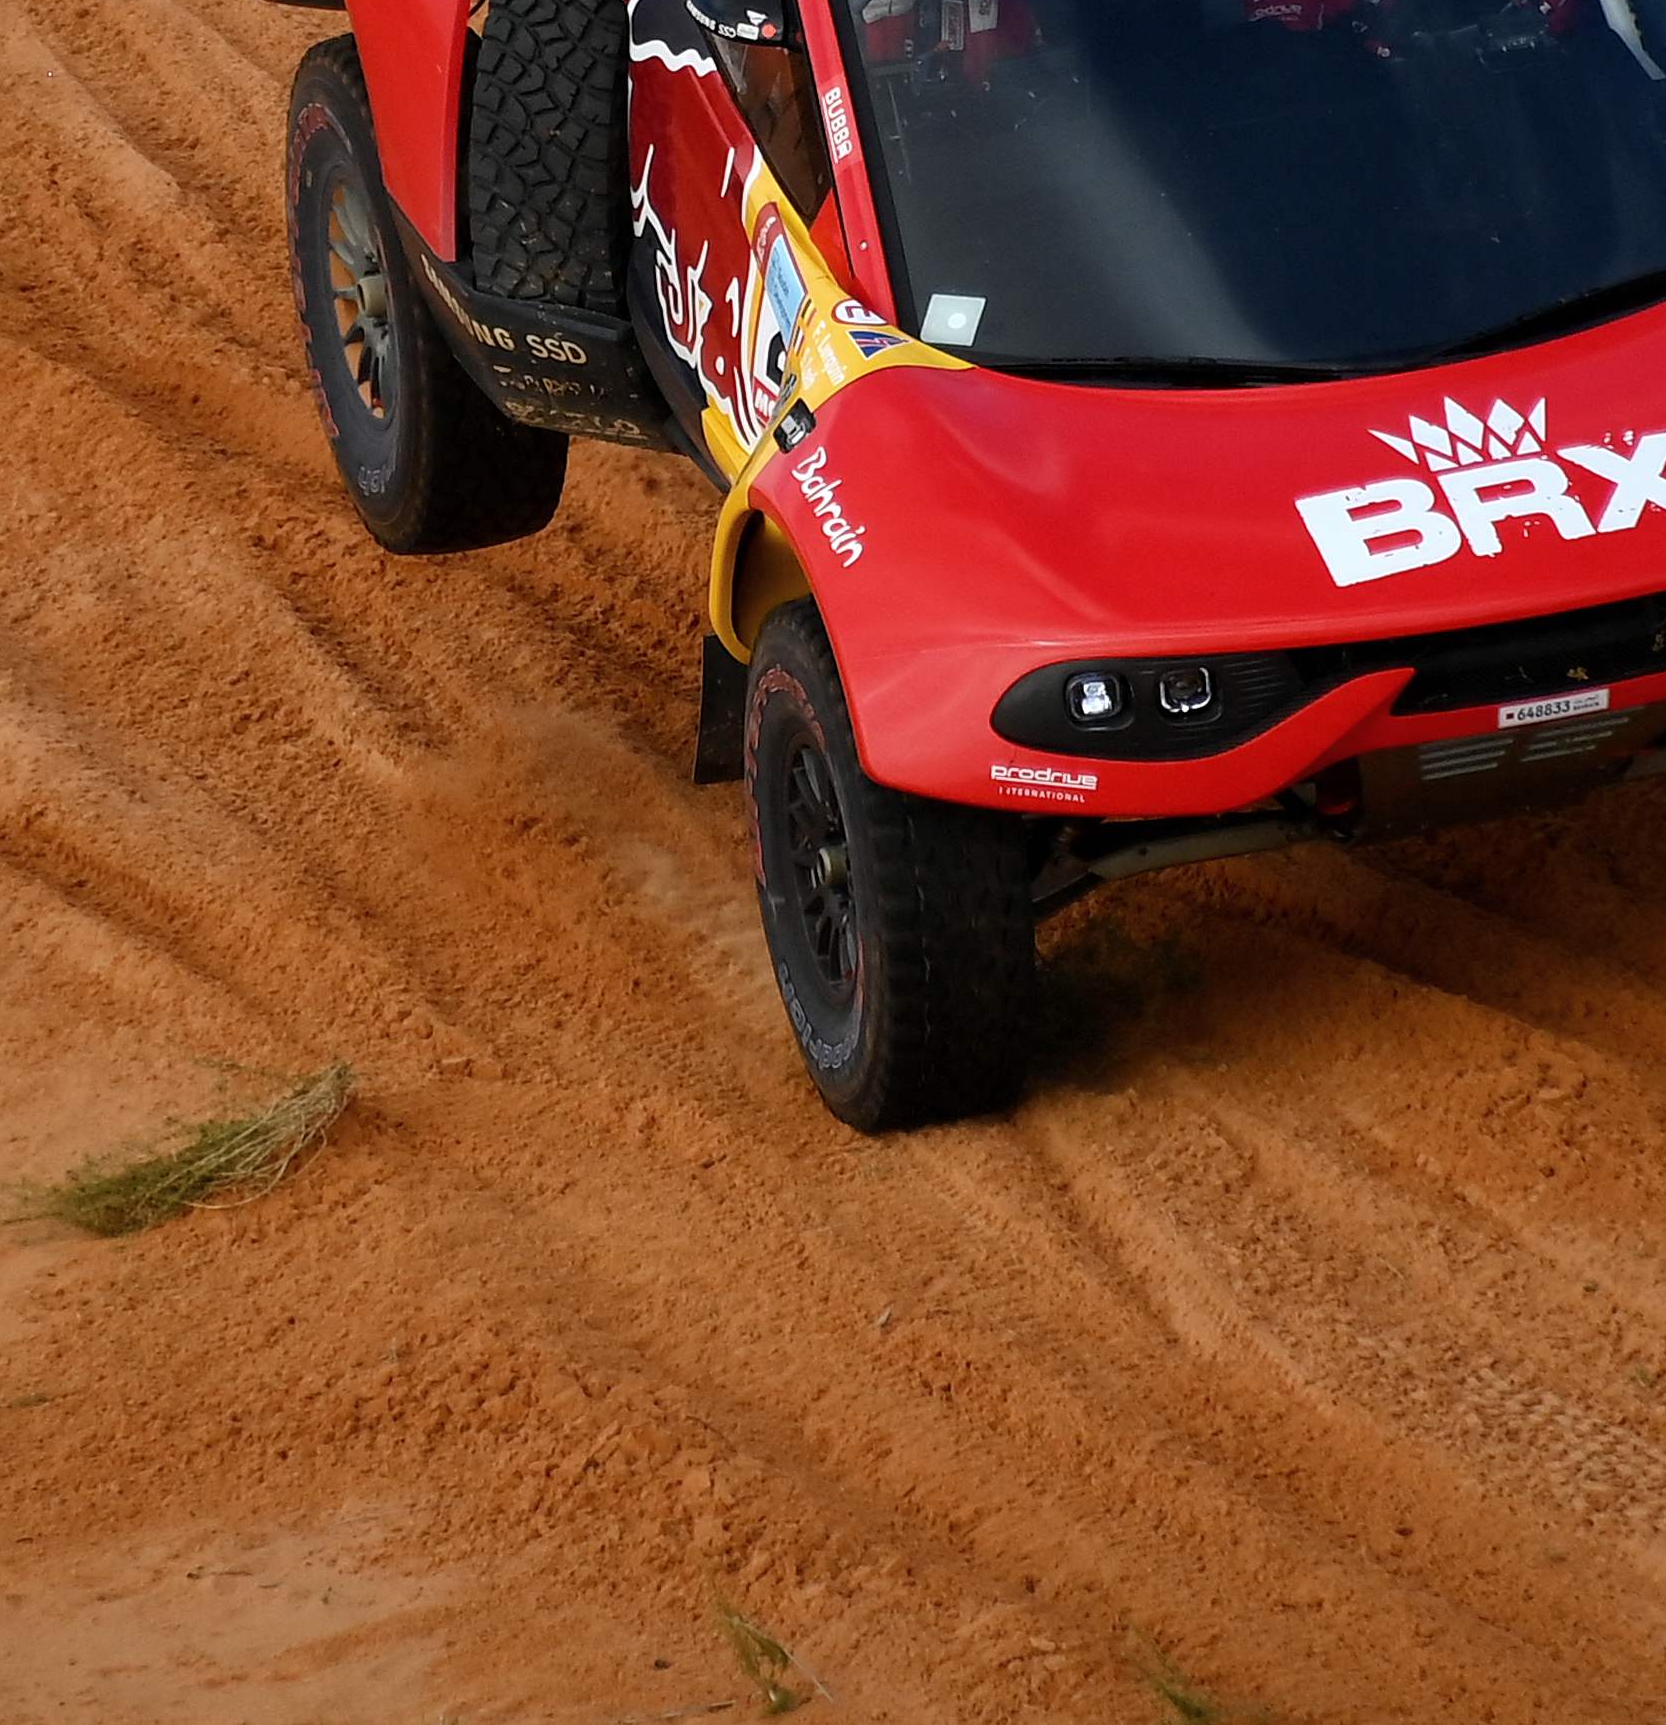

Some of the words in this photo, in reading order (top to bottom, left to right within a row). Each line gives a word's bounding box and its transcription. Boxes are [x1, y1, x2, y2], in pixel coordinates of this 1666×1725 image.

[525, 333, 588, 365] SSD
[791, 446, 867, 569] Bahrain
[1516, 700, 1571, 721] 648833
[990, 764, 1098, 787] prodrive
